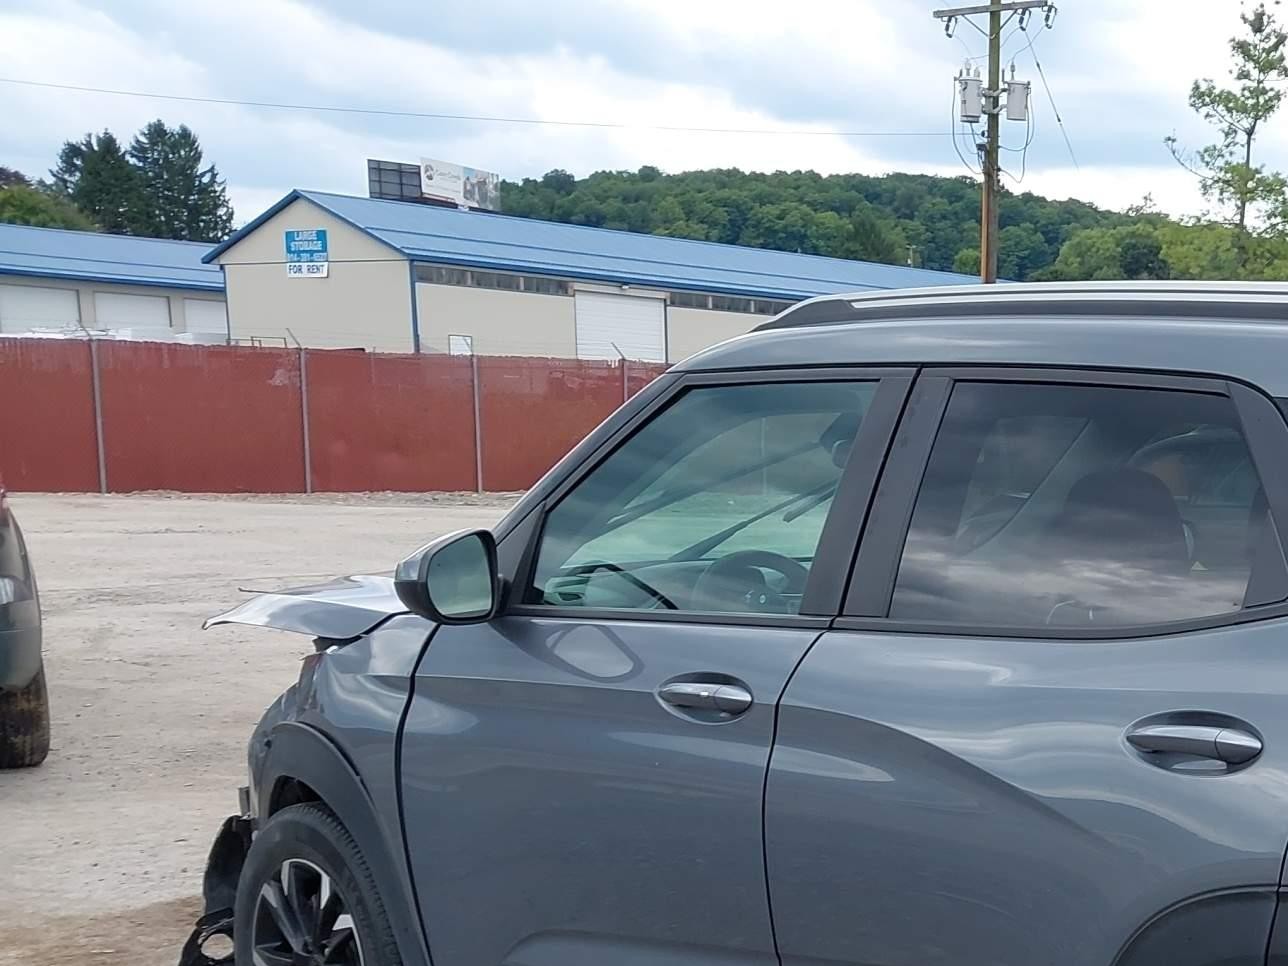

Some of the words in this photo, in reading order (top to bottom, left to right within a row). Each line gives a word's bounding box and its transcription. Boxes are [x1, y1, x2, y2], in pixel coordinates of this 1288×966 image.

[290, 240, 323, 251] STORAGE
[288, 264, 304, 275] FOR
[306, 264, 325, 275] RENT
